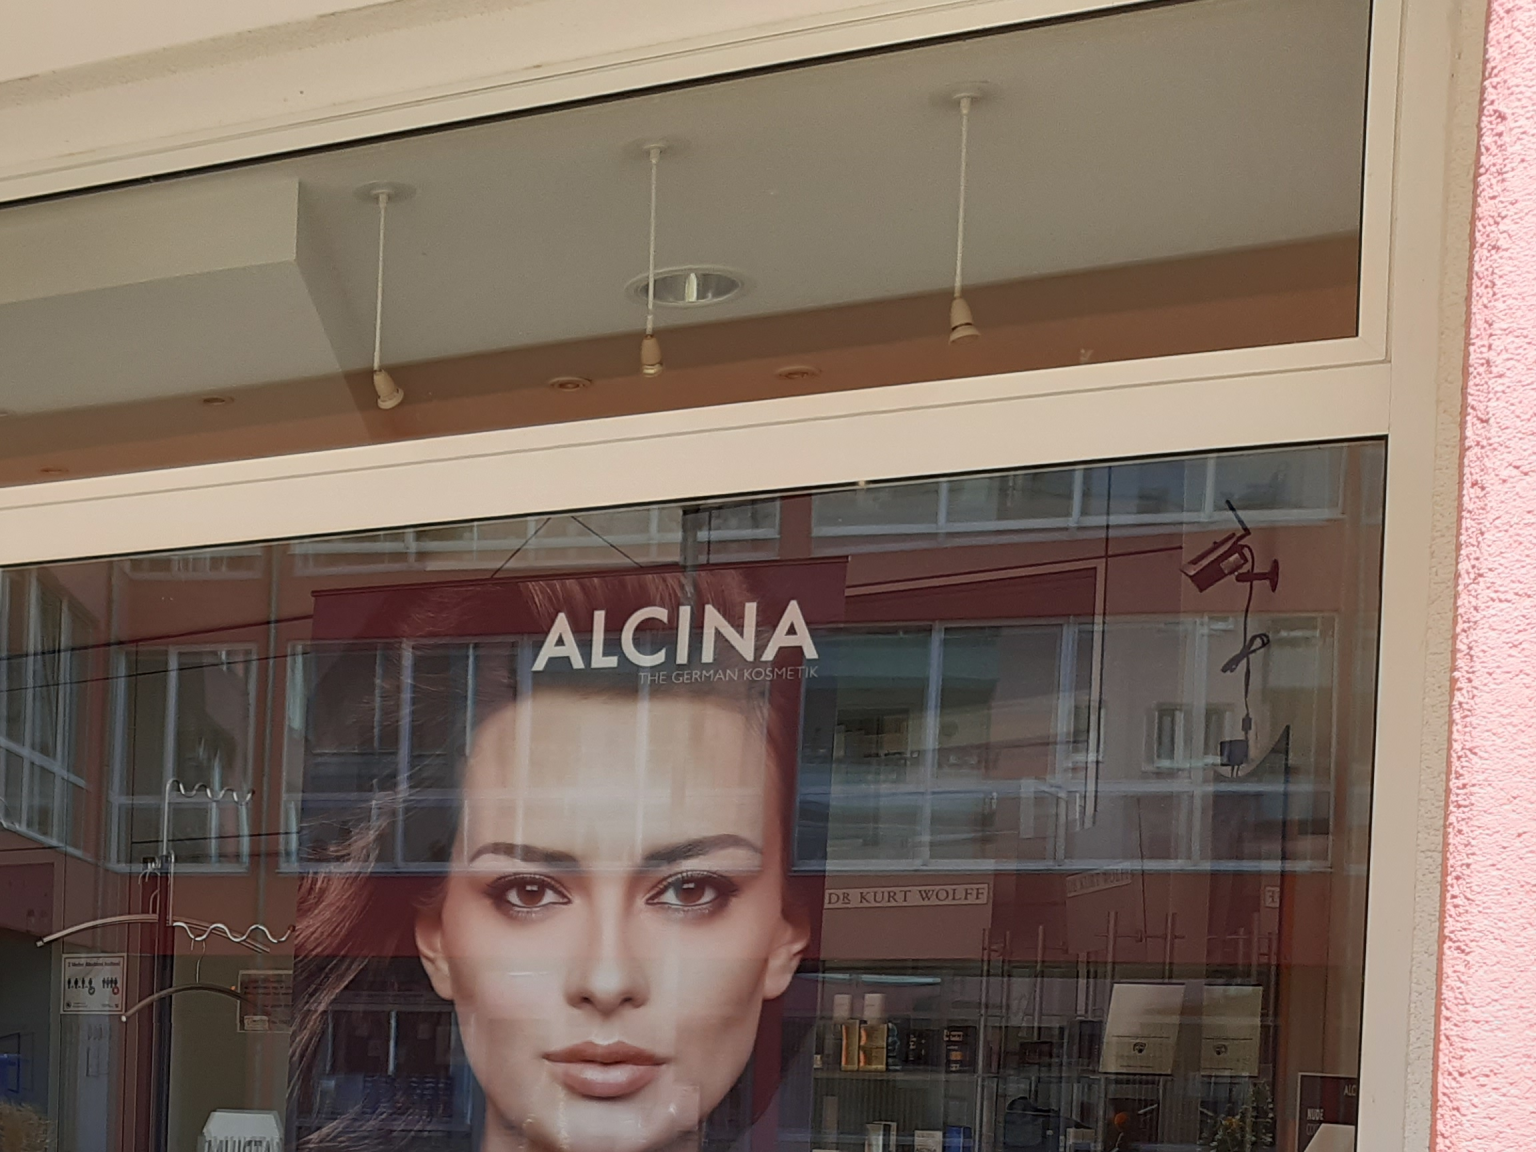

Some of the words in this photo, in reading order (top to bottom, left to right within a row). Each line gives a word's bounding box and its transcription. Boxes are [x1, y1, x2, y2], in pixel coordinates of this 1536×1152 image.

[531, 599, 820, 672] ALCINA
[638, 671, 667, 685] THE
[671, 668, 739, 684] GERMAN
[743, 665, 820, 682] KOSMETIK
[859, 889, 912, 904] KURT
[918, 886, 985, 902] WOLFF
